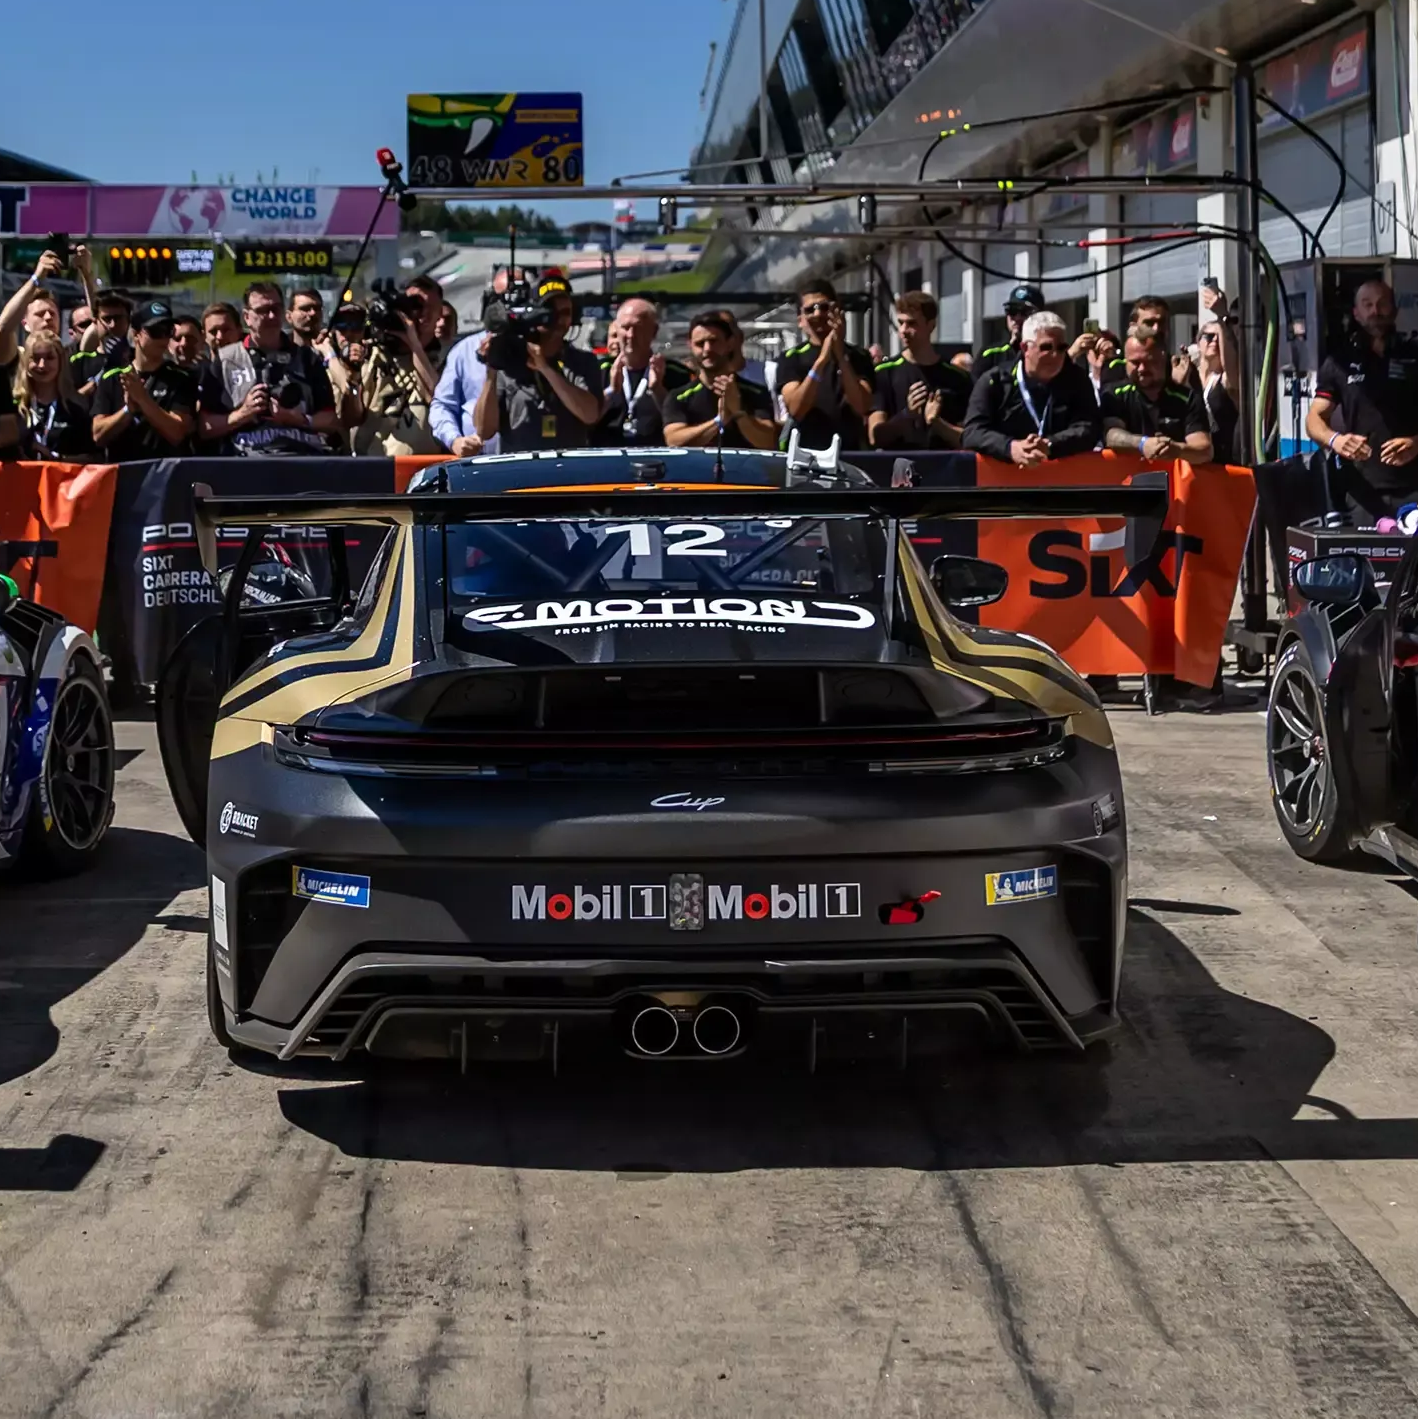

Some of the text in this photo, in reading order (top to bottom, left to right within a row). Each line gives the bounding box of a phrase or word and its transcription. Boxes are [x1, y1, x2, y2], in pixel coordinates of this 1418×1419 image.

[410, 155, 454, 185] 48
[542, 155, 581, 183] 80
[231, 186, 317, 205] CHANGE
[248, 205, 318, 220] WORLD
[244, 251, 328, 267] 12:15:00
[604, 523, 728, 556] 12
[143, 555, 174, 573] SIXT
[143, 570, 212, 591] CARRERA
[554, 621, 786, 635] FROM SIM RACING TO REAL RACING
[650, 791, 726, 811] Cup
[231, 810, 260, 832] BRACKET
[307, 878, 360, 898] MICHELIN
[512, 885, 622, 921] Mobil
[709, 884, 818, 920] Mobil
